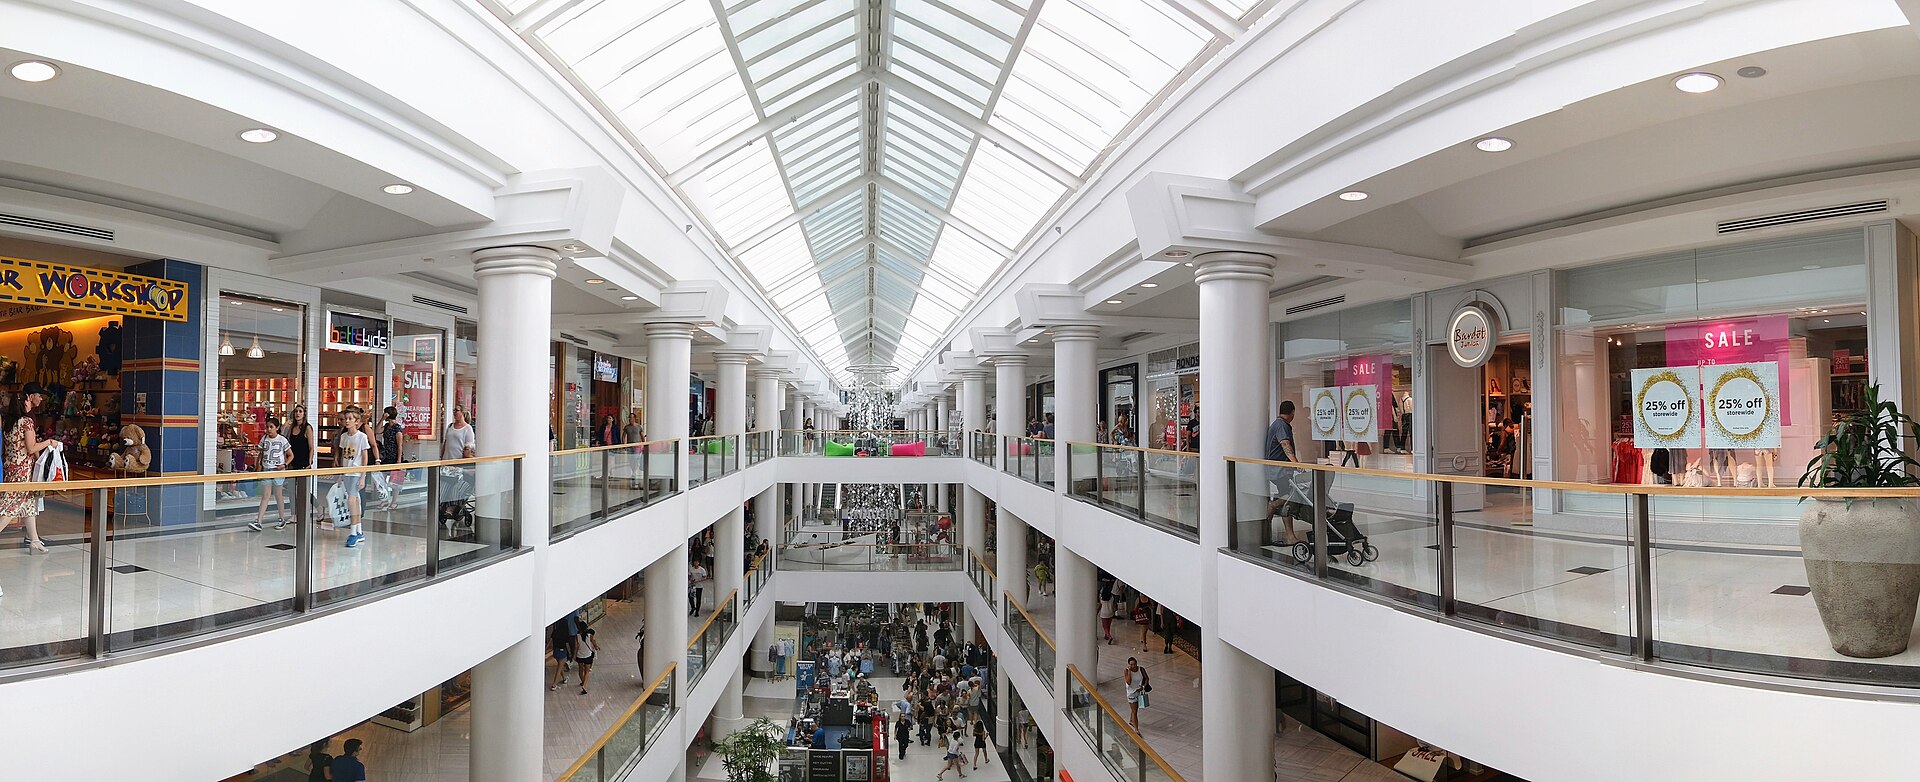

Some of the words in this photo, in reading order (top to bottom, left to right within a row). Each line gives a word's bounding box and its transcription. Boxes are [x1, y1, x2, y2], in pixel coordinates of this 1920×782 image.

[39, 270, 183, 312] WORKSHOP
[1704, 329, 1753, 349] SALE
[1353, 362, 1376, 375] SALE
[404, 370, 432, 390] SALE
[1645, 401, 1668, 411] 25%
[1670, 400, 1686, 410] off
[1718, 399, 1743, 409] 25%
[1746, 398, 1763, 408] off
[418, 412, 431, 422] OFF
[1327, 408, 1335, 416] off
[1349, 408, 1360, 416] 25%
[1360, 408, 1369, 416] off
